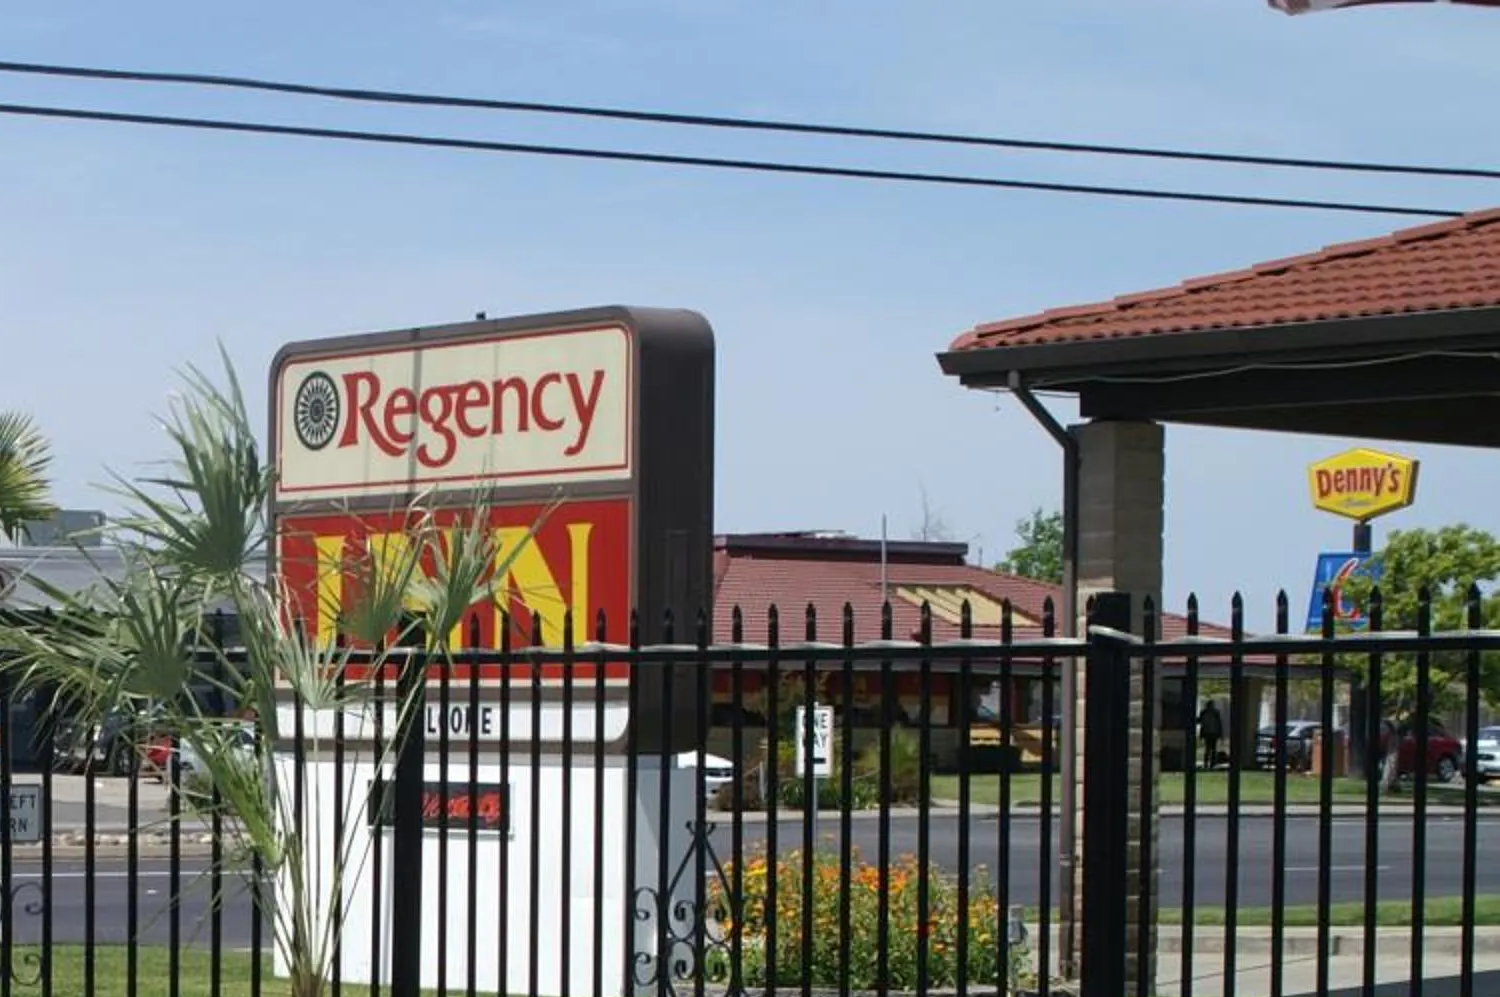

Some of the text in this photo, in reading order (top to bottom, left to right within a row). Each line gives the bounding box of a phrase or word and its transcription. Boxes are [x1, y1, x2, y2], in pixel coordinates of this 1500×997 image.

[338, 368, 605, 468] Regency
[1315, 461, 1401, 499] Denny's
[312, 521, 595, 667] INN
